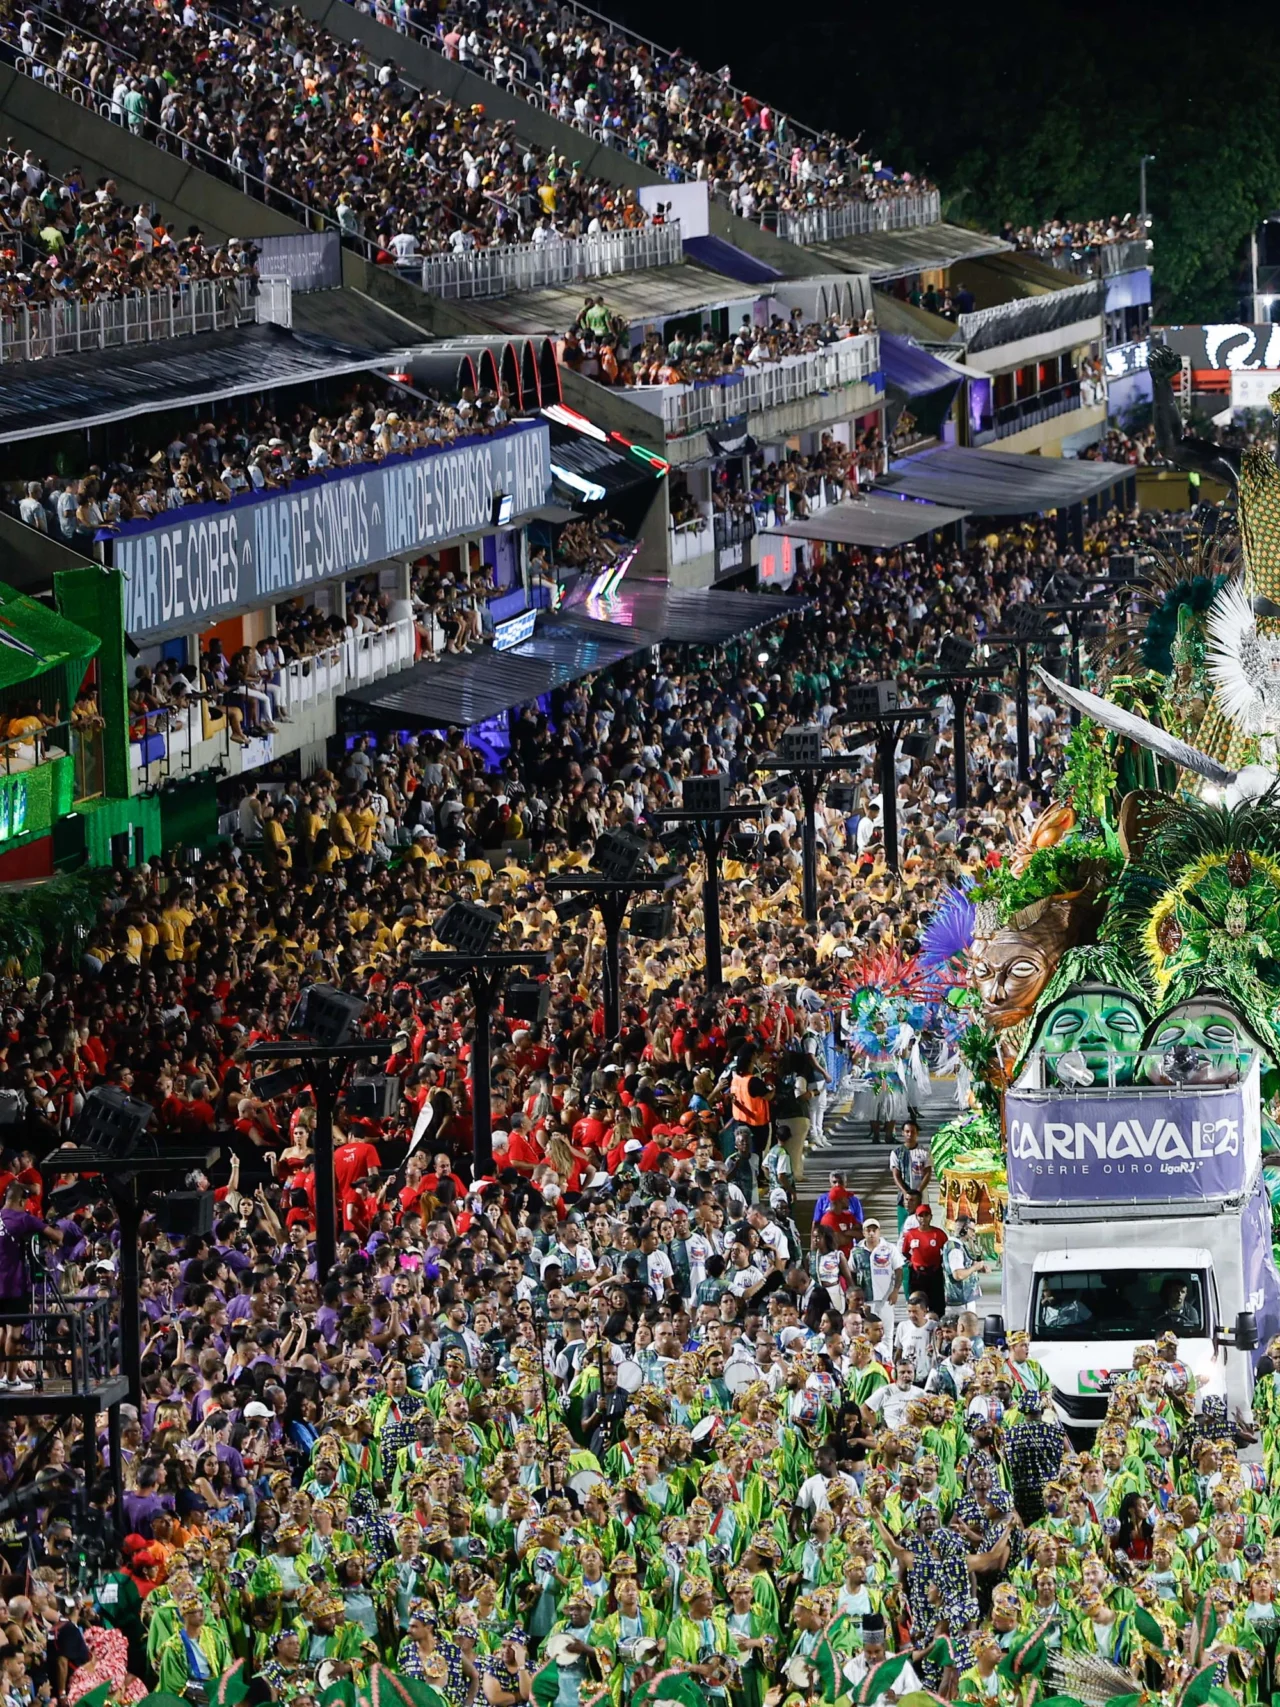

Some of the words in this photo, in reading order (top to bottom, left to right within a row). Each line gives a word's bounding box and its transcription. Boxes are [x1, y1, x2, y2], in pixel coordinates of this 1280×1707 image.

[117, 532, 160, 633] MAR
[160, 529, 183, 621] DE
[187, 514, 239, 615] CORES
[254, 499, 293, 596] MAR
[291, 495, 313, 584] DE
[314, 480, 370, 579] SONHOS
[382, 463, 418, 553] MAR
[416, 459, 434, 540] DE
[434, 446, 494, 535] SORRISOS
[1010, 1118, 1215, 1161] CARNAVAL
[1035, 1162, 1090, 1175] SÉRIE
[1103, 1163, 1153, 1174] OURO
[1160, 1161, 1196, 1175] LigaRJ
